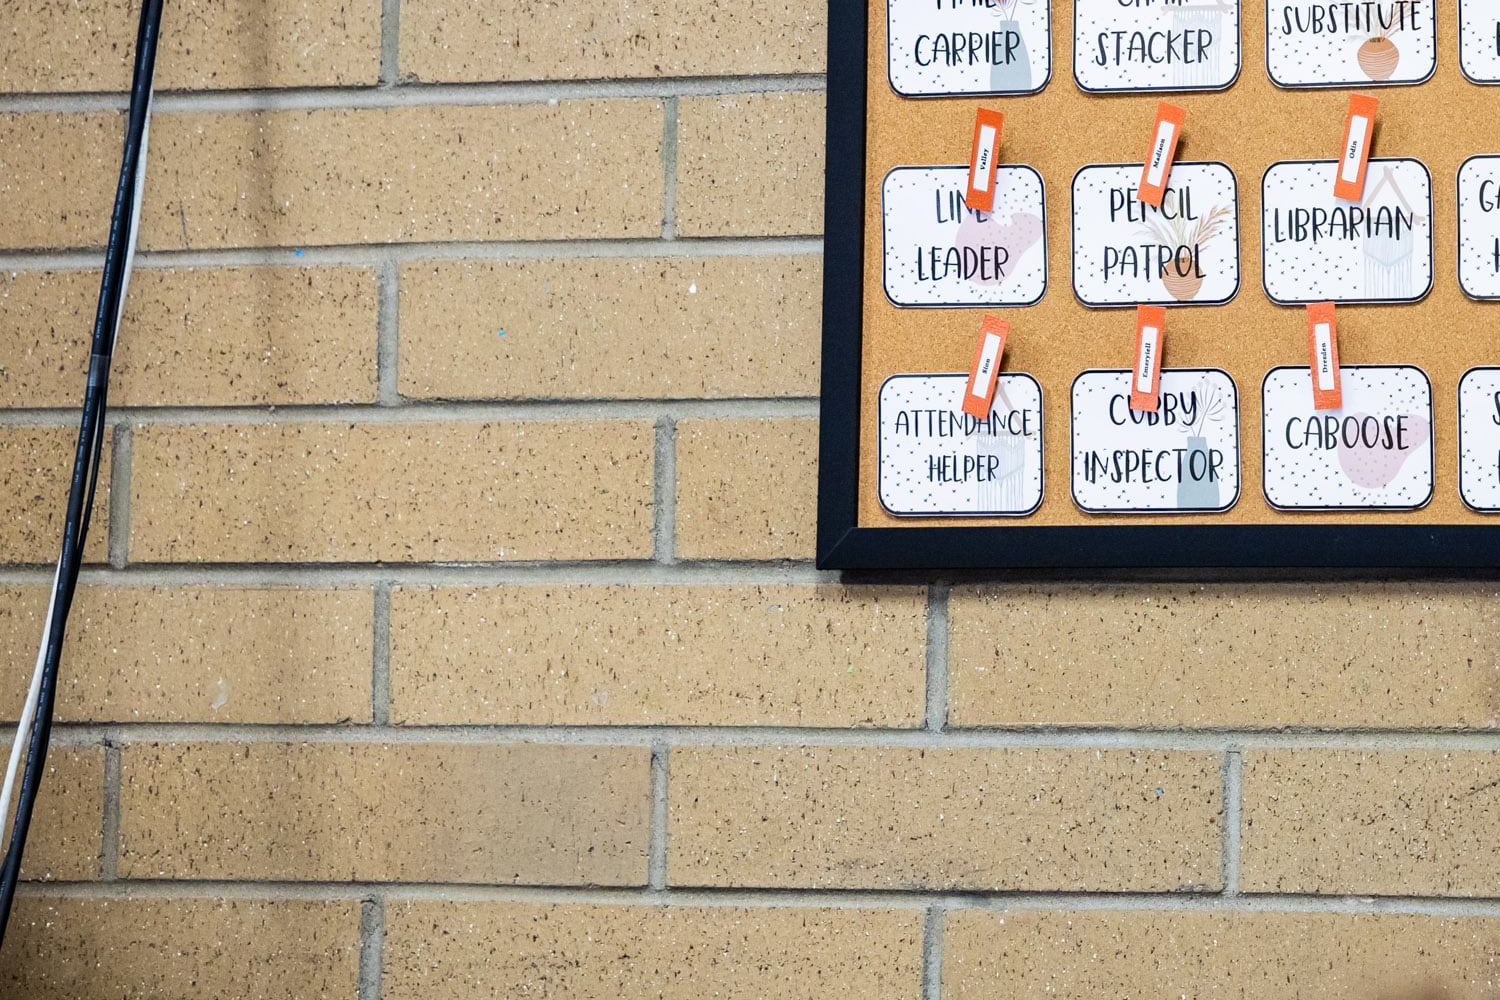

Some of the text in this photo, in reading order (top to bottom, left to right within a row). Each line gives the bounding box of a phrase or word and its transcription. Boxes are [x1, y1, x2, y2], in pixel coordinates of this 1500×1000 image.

[1281, 0, 1422, 35] SUBSTITUTE
[914, 31, 1020, 68] CARRIER
[1095, 29, 1212, 67] STACKER
[980, 148, 989, 170] Valley
[1153, 138, 1165, 169] Madison
[1349, 140, 1357, 159] Odin
[1274, 205, 1413, 242] LIBRARIAN
[917, 245, 1009, 281] LEADER
[1104, 243, 1206, 280] PATROL
[894, 409, 1032, 437] ATTENDANCE
[1285, 414, 1409, 450] CABOOSE
[928, 454, 999, 482] HELPER
[1084, 449, 1224, 484] INSPECTOR
